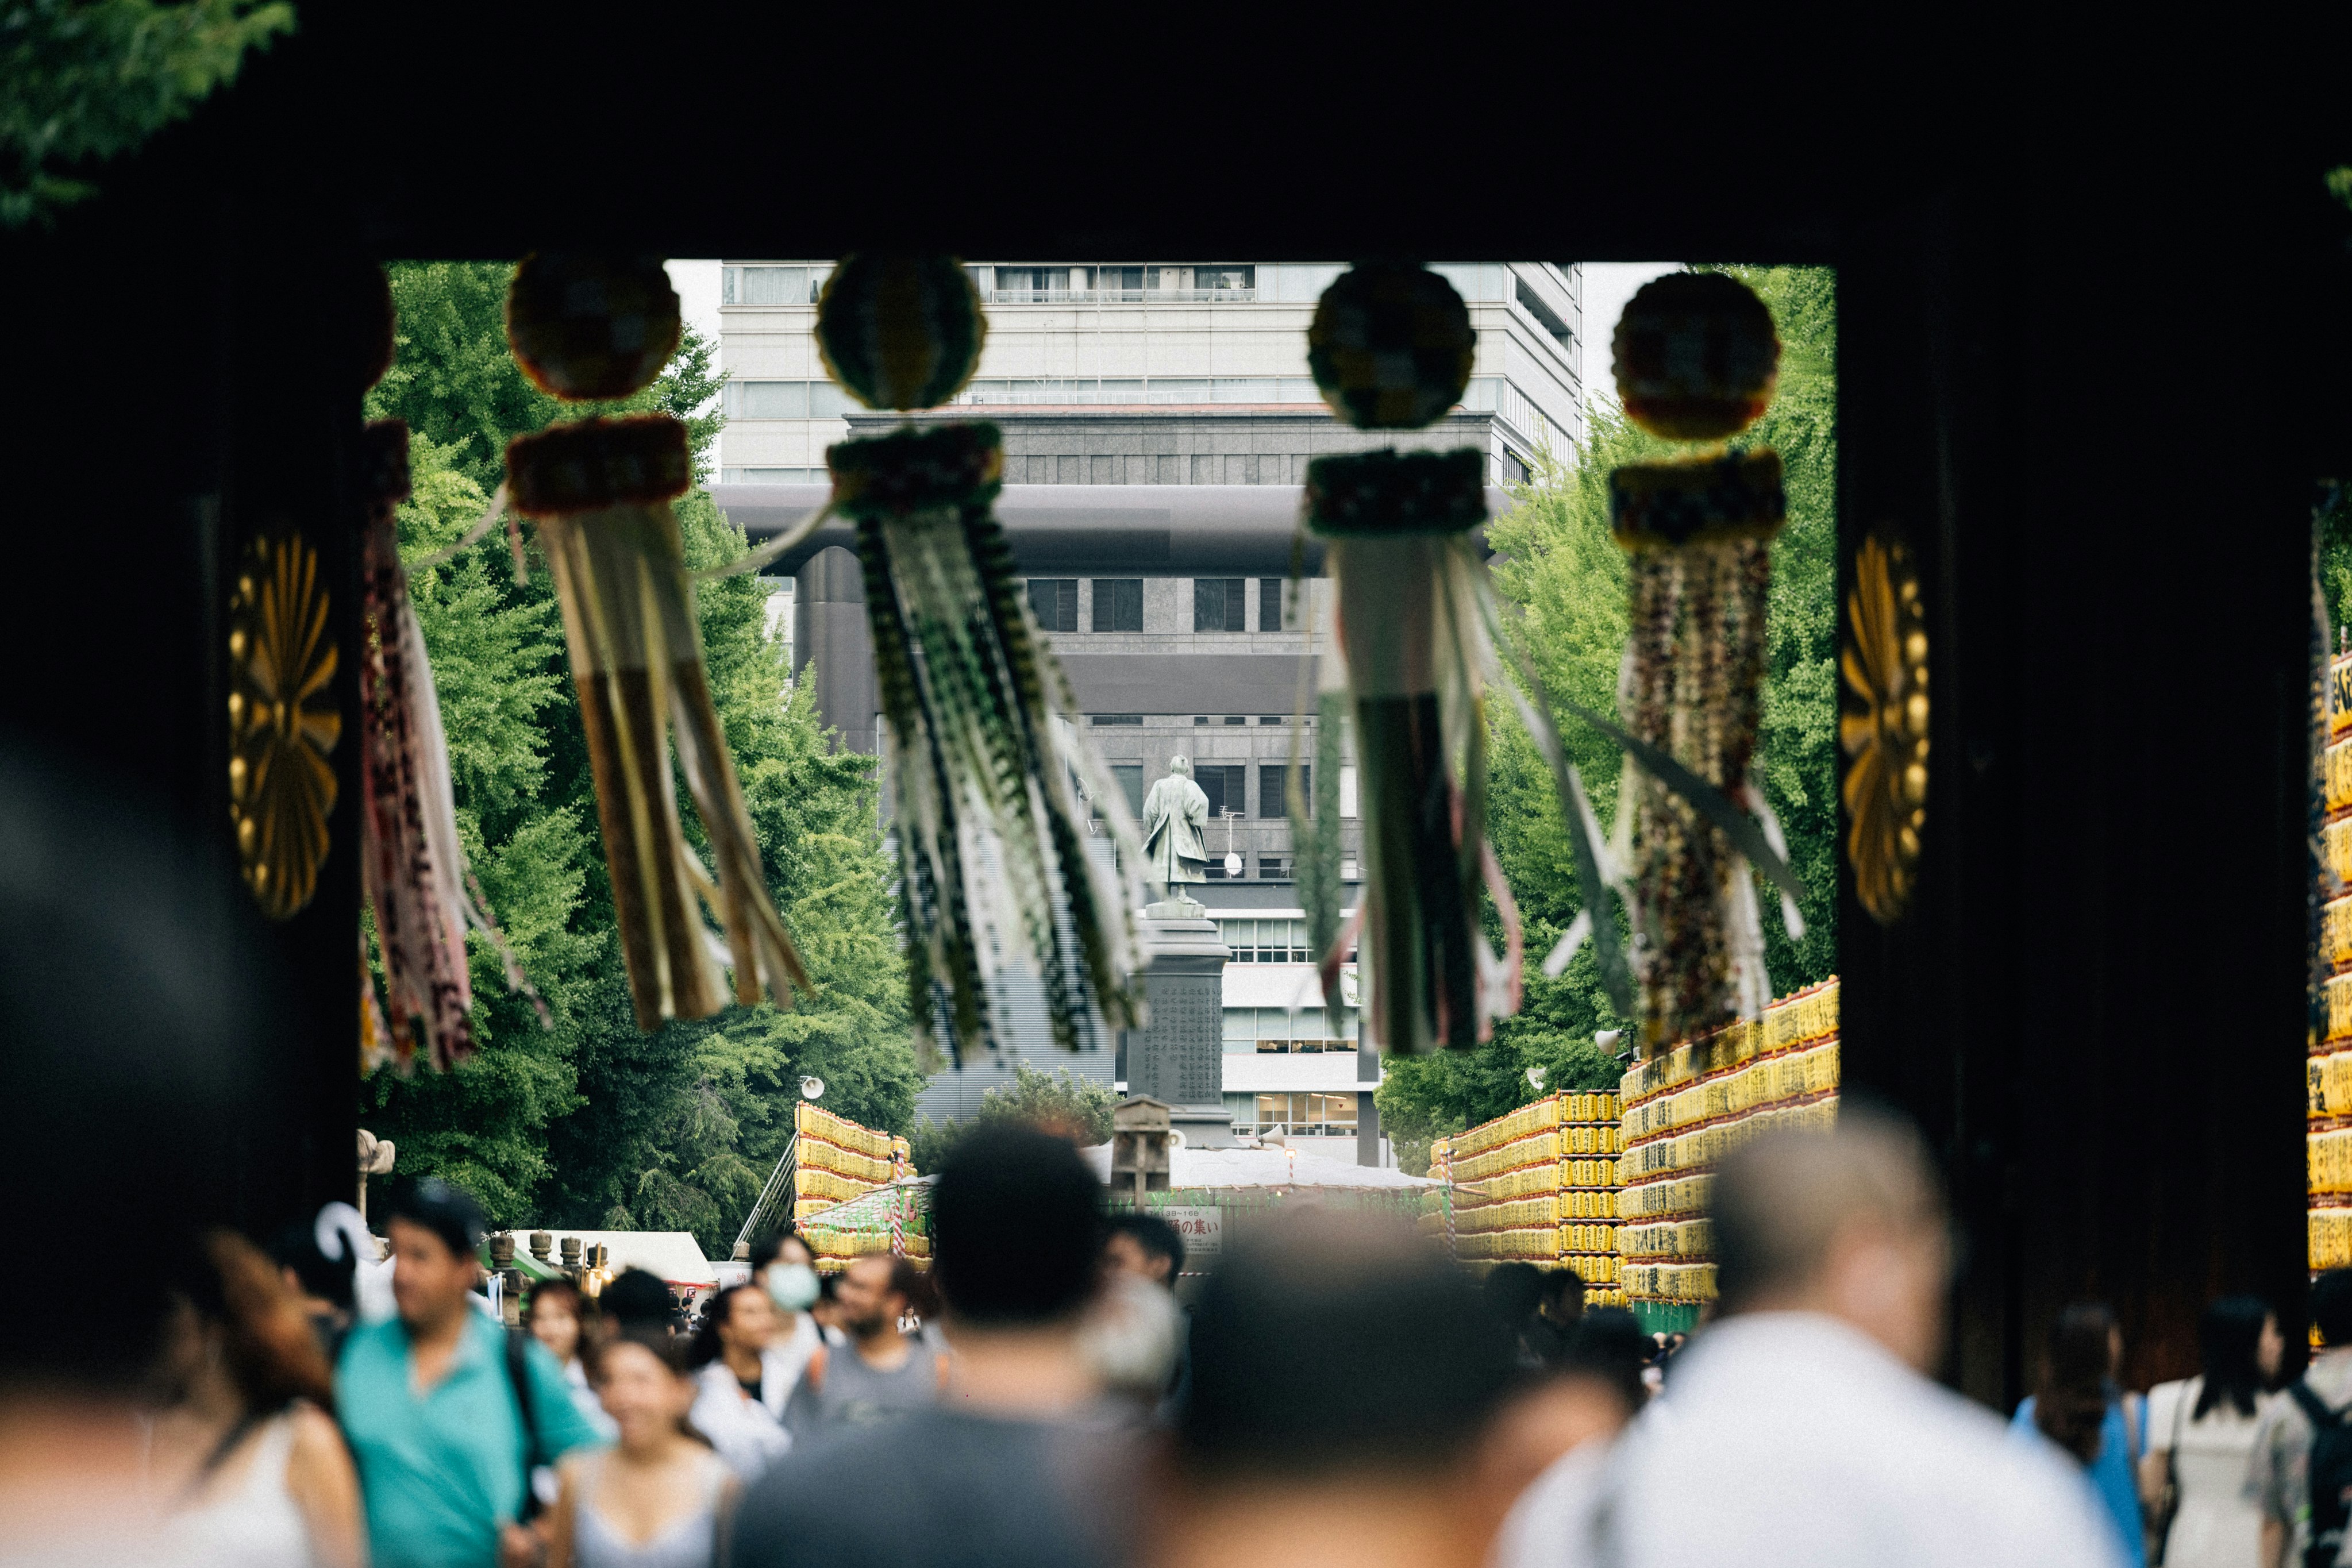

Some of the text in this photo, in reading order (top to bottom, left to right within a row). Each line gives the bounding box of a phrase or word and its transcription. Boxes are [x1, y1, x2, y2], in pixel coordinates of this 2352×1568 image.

[1164, 1219, 1218, 1235] 踊の集い
[687, 1288, 696, 1297] 区
